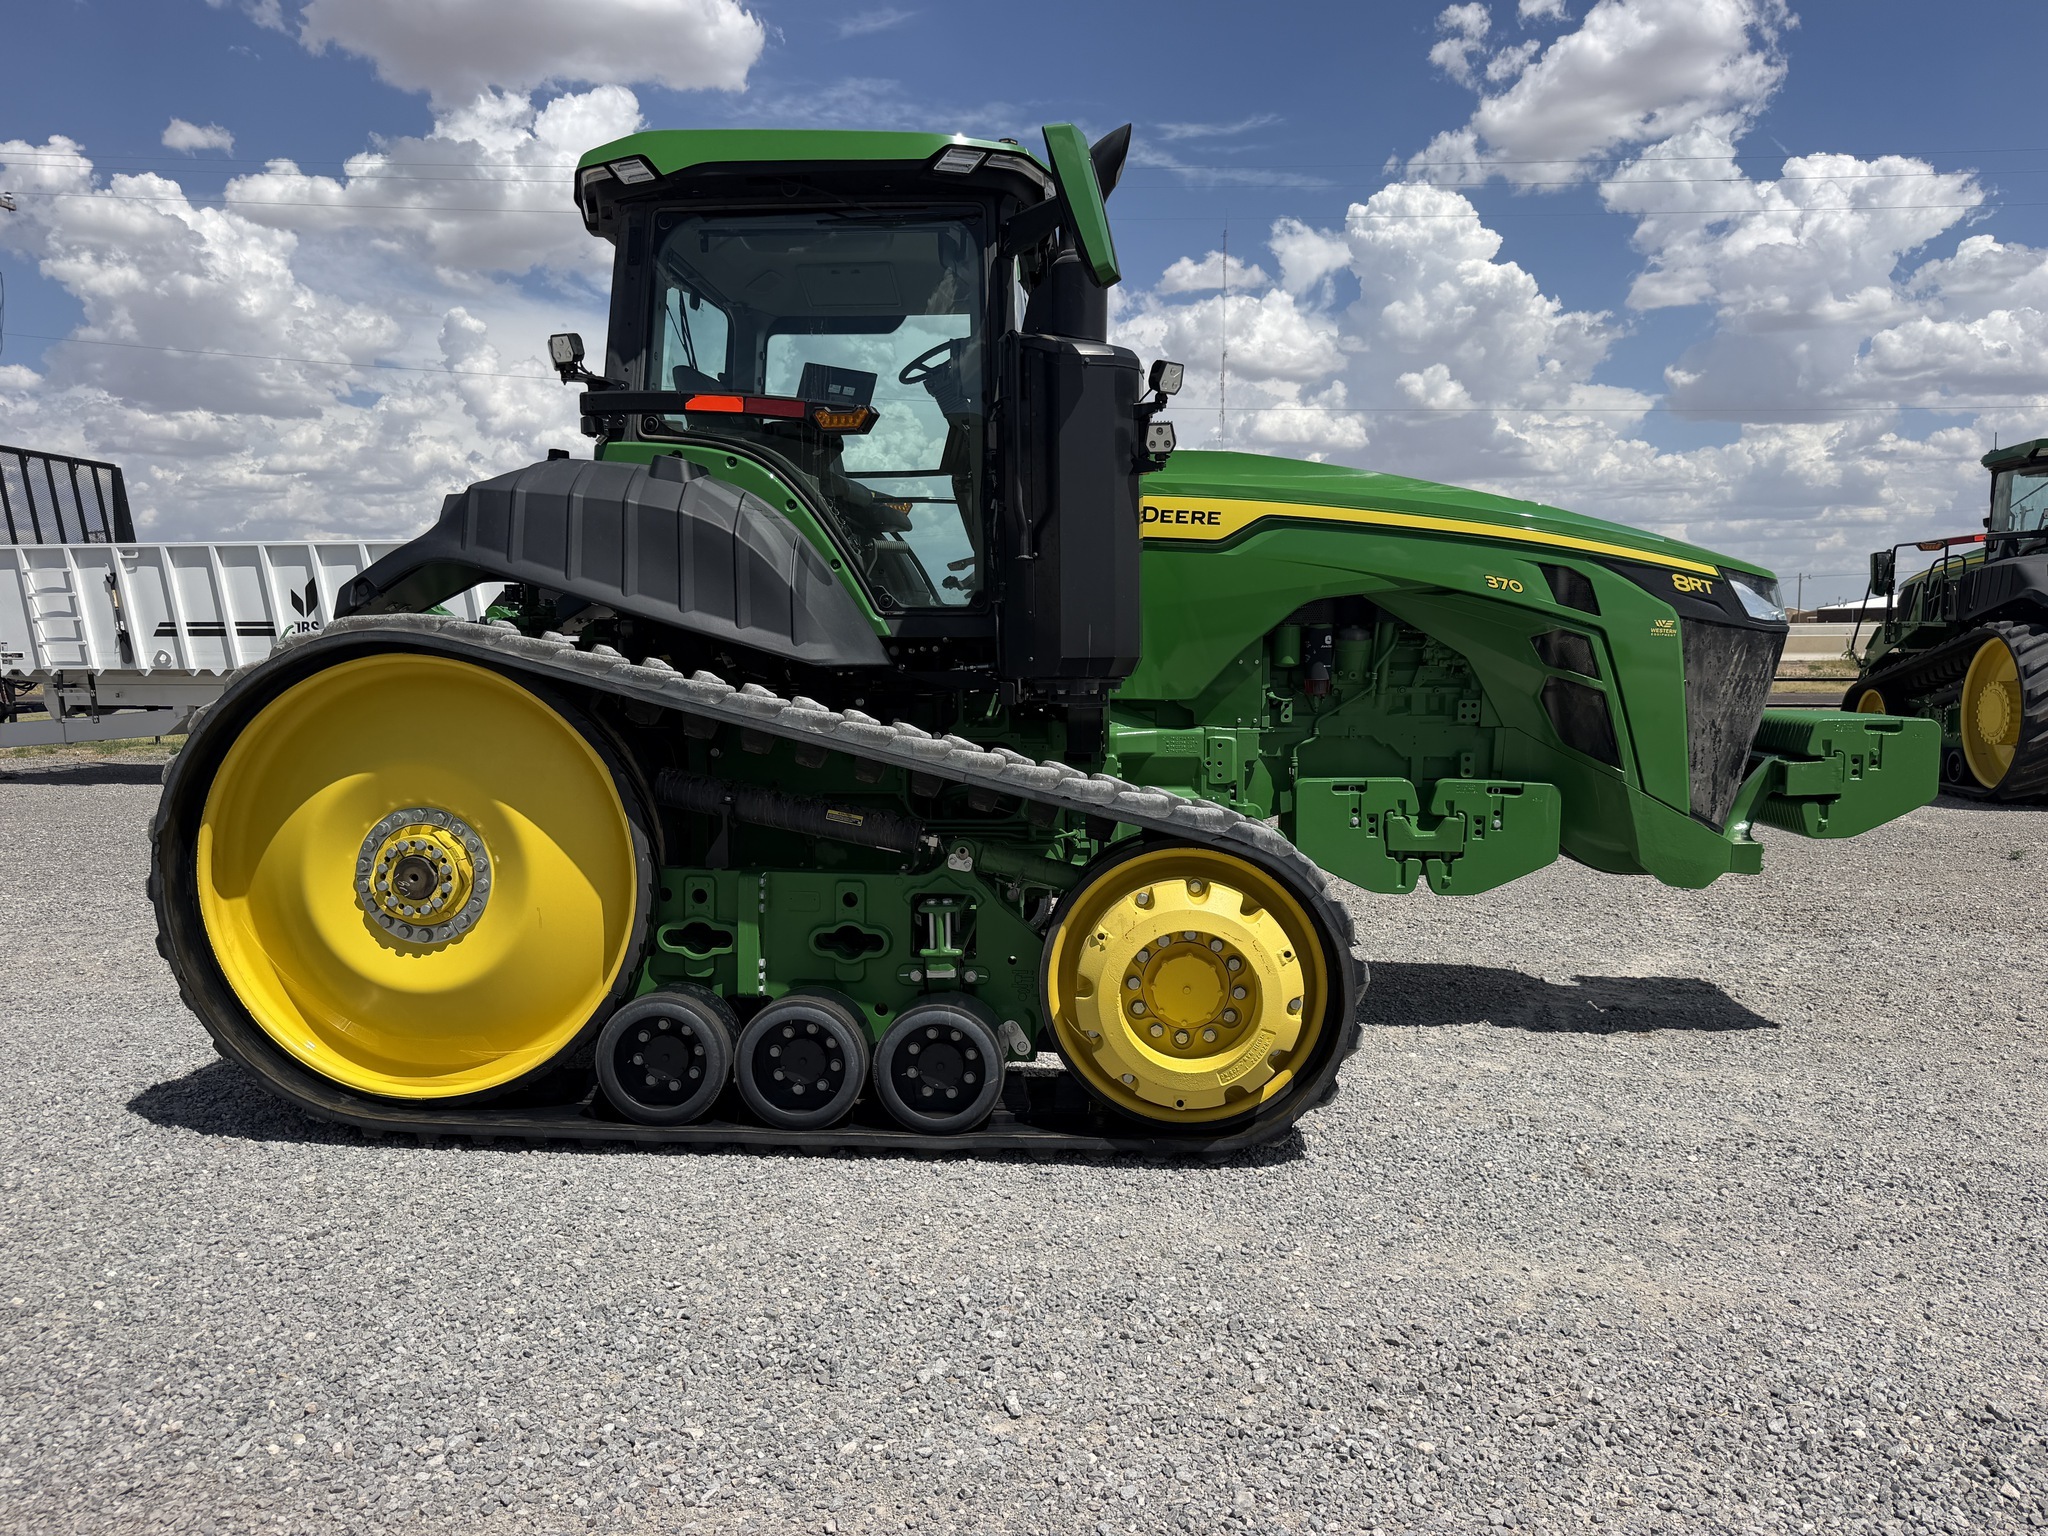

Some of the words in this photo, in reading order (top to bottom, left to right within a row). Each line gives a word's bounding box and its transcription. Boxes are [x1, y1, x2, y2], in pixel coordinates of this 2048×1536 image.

[1142, 505, 1222, 526] DEERE
[1484, 575, 1524, 593] 370
[1672, 574, 1713, 594] 8RT
